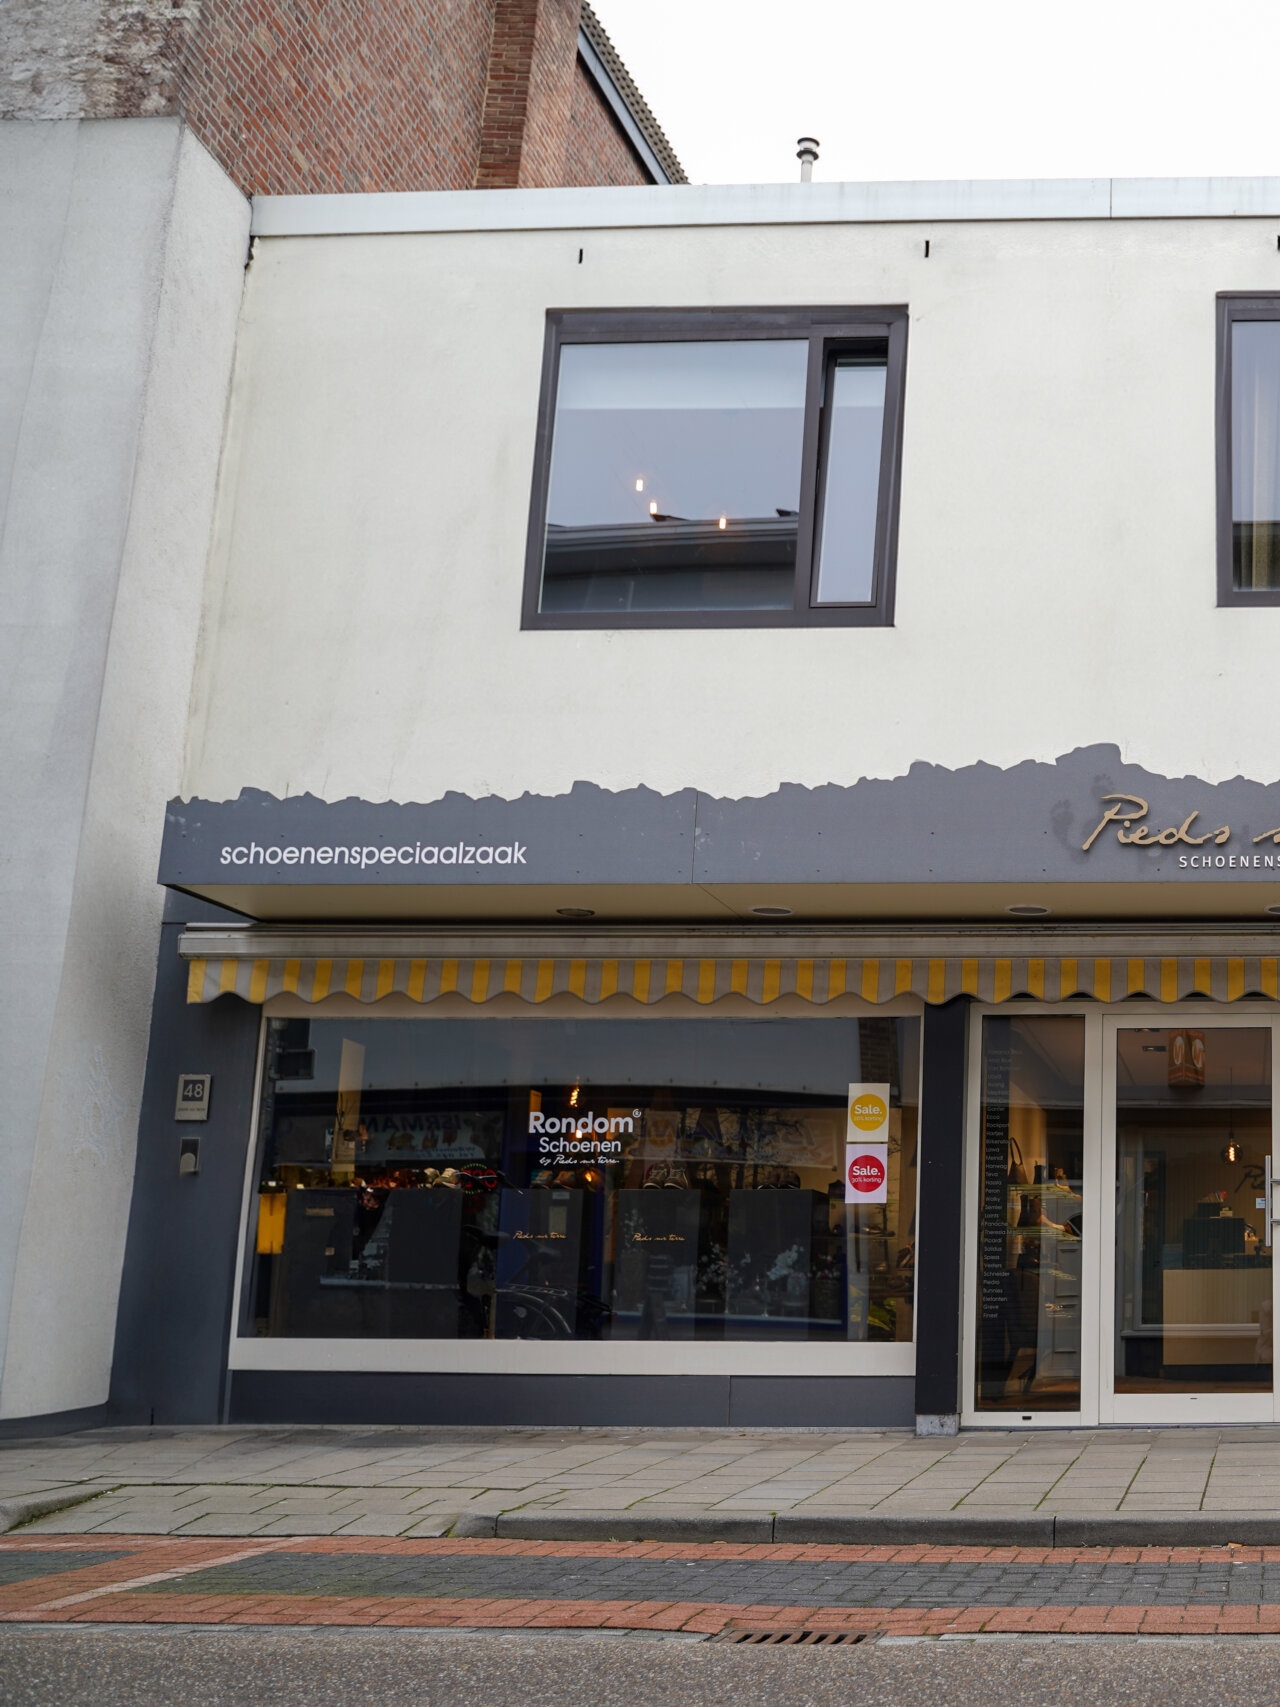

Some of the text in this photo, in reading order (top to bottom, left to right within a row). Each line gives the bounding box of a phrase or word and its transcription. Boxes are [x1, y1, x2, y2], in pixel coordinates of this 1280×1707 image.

[1082, 794, 1230, 851] Pieds
[220, 842, 528, 869] schoenenspeciaalzaak
[184, 1083, 203, 1098] 48
[539, 1137, 621, 1152] Schoenen
[852, 1166, 881, 1176] Sale.
